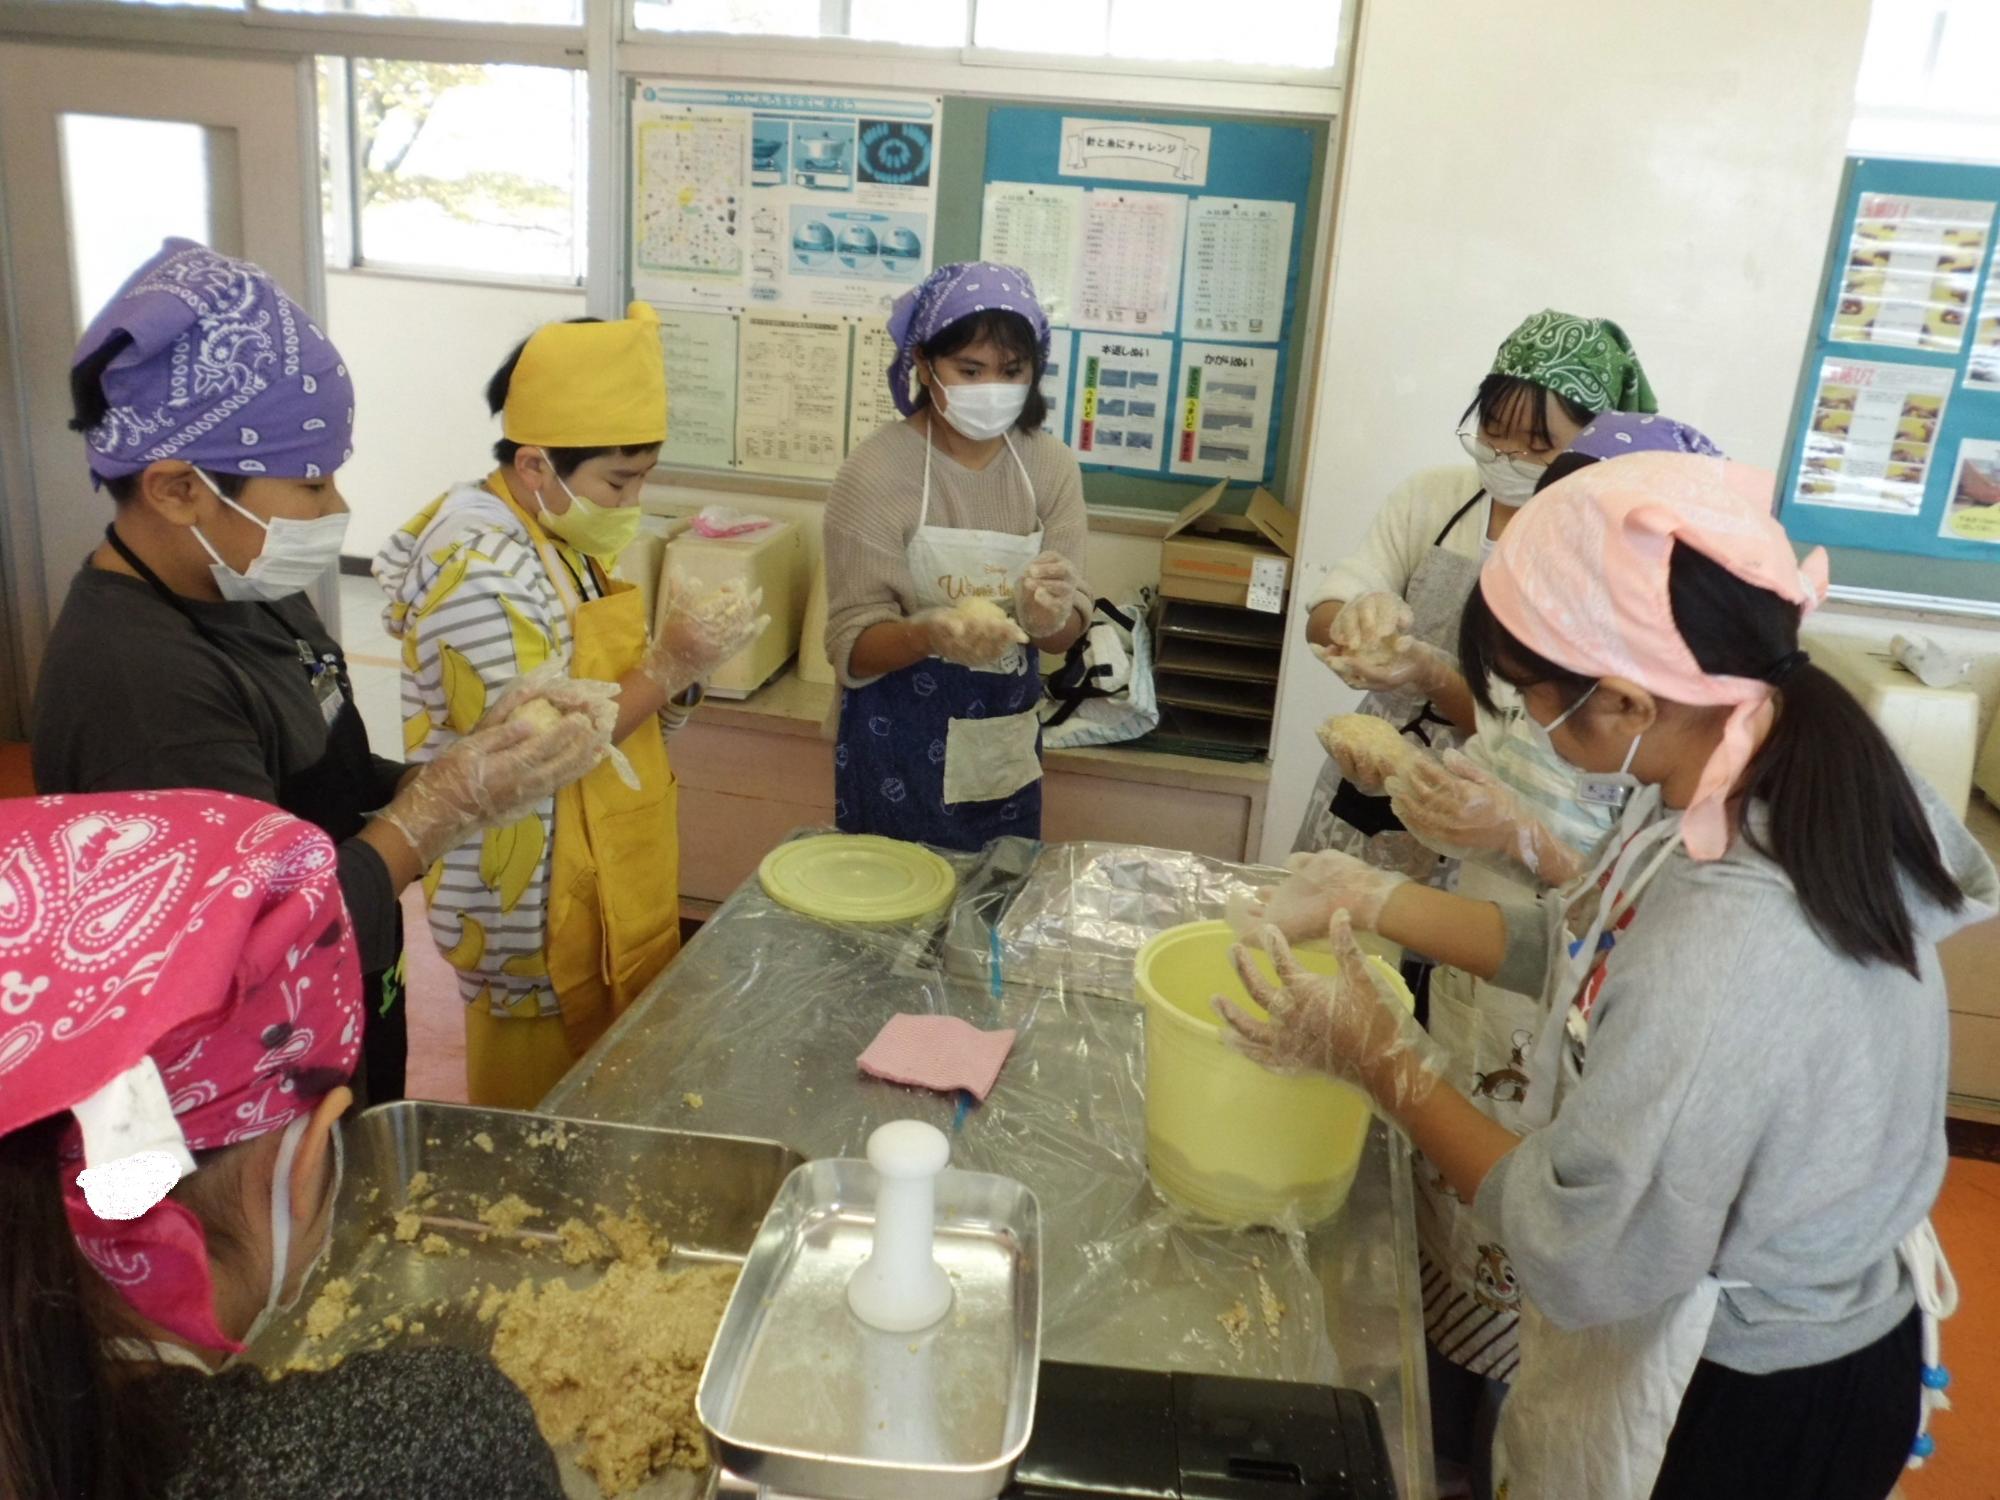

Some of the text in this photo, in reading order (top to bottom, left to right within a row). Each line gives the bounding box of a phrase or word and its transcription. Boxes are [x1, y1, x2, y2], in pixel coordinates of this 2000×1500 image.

[1086, 136, 1176, 154] 針と糸にチャレンジ
[1101, 344, 1150, 358] 本返しぬい
